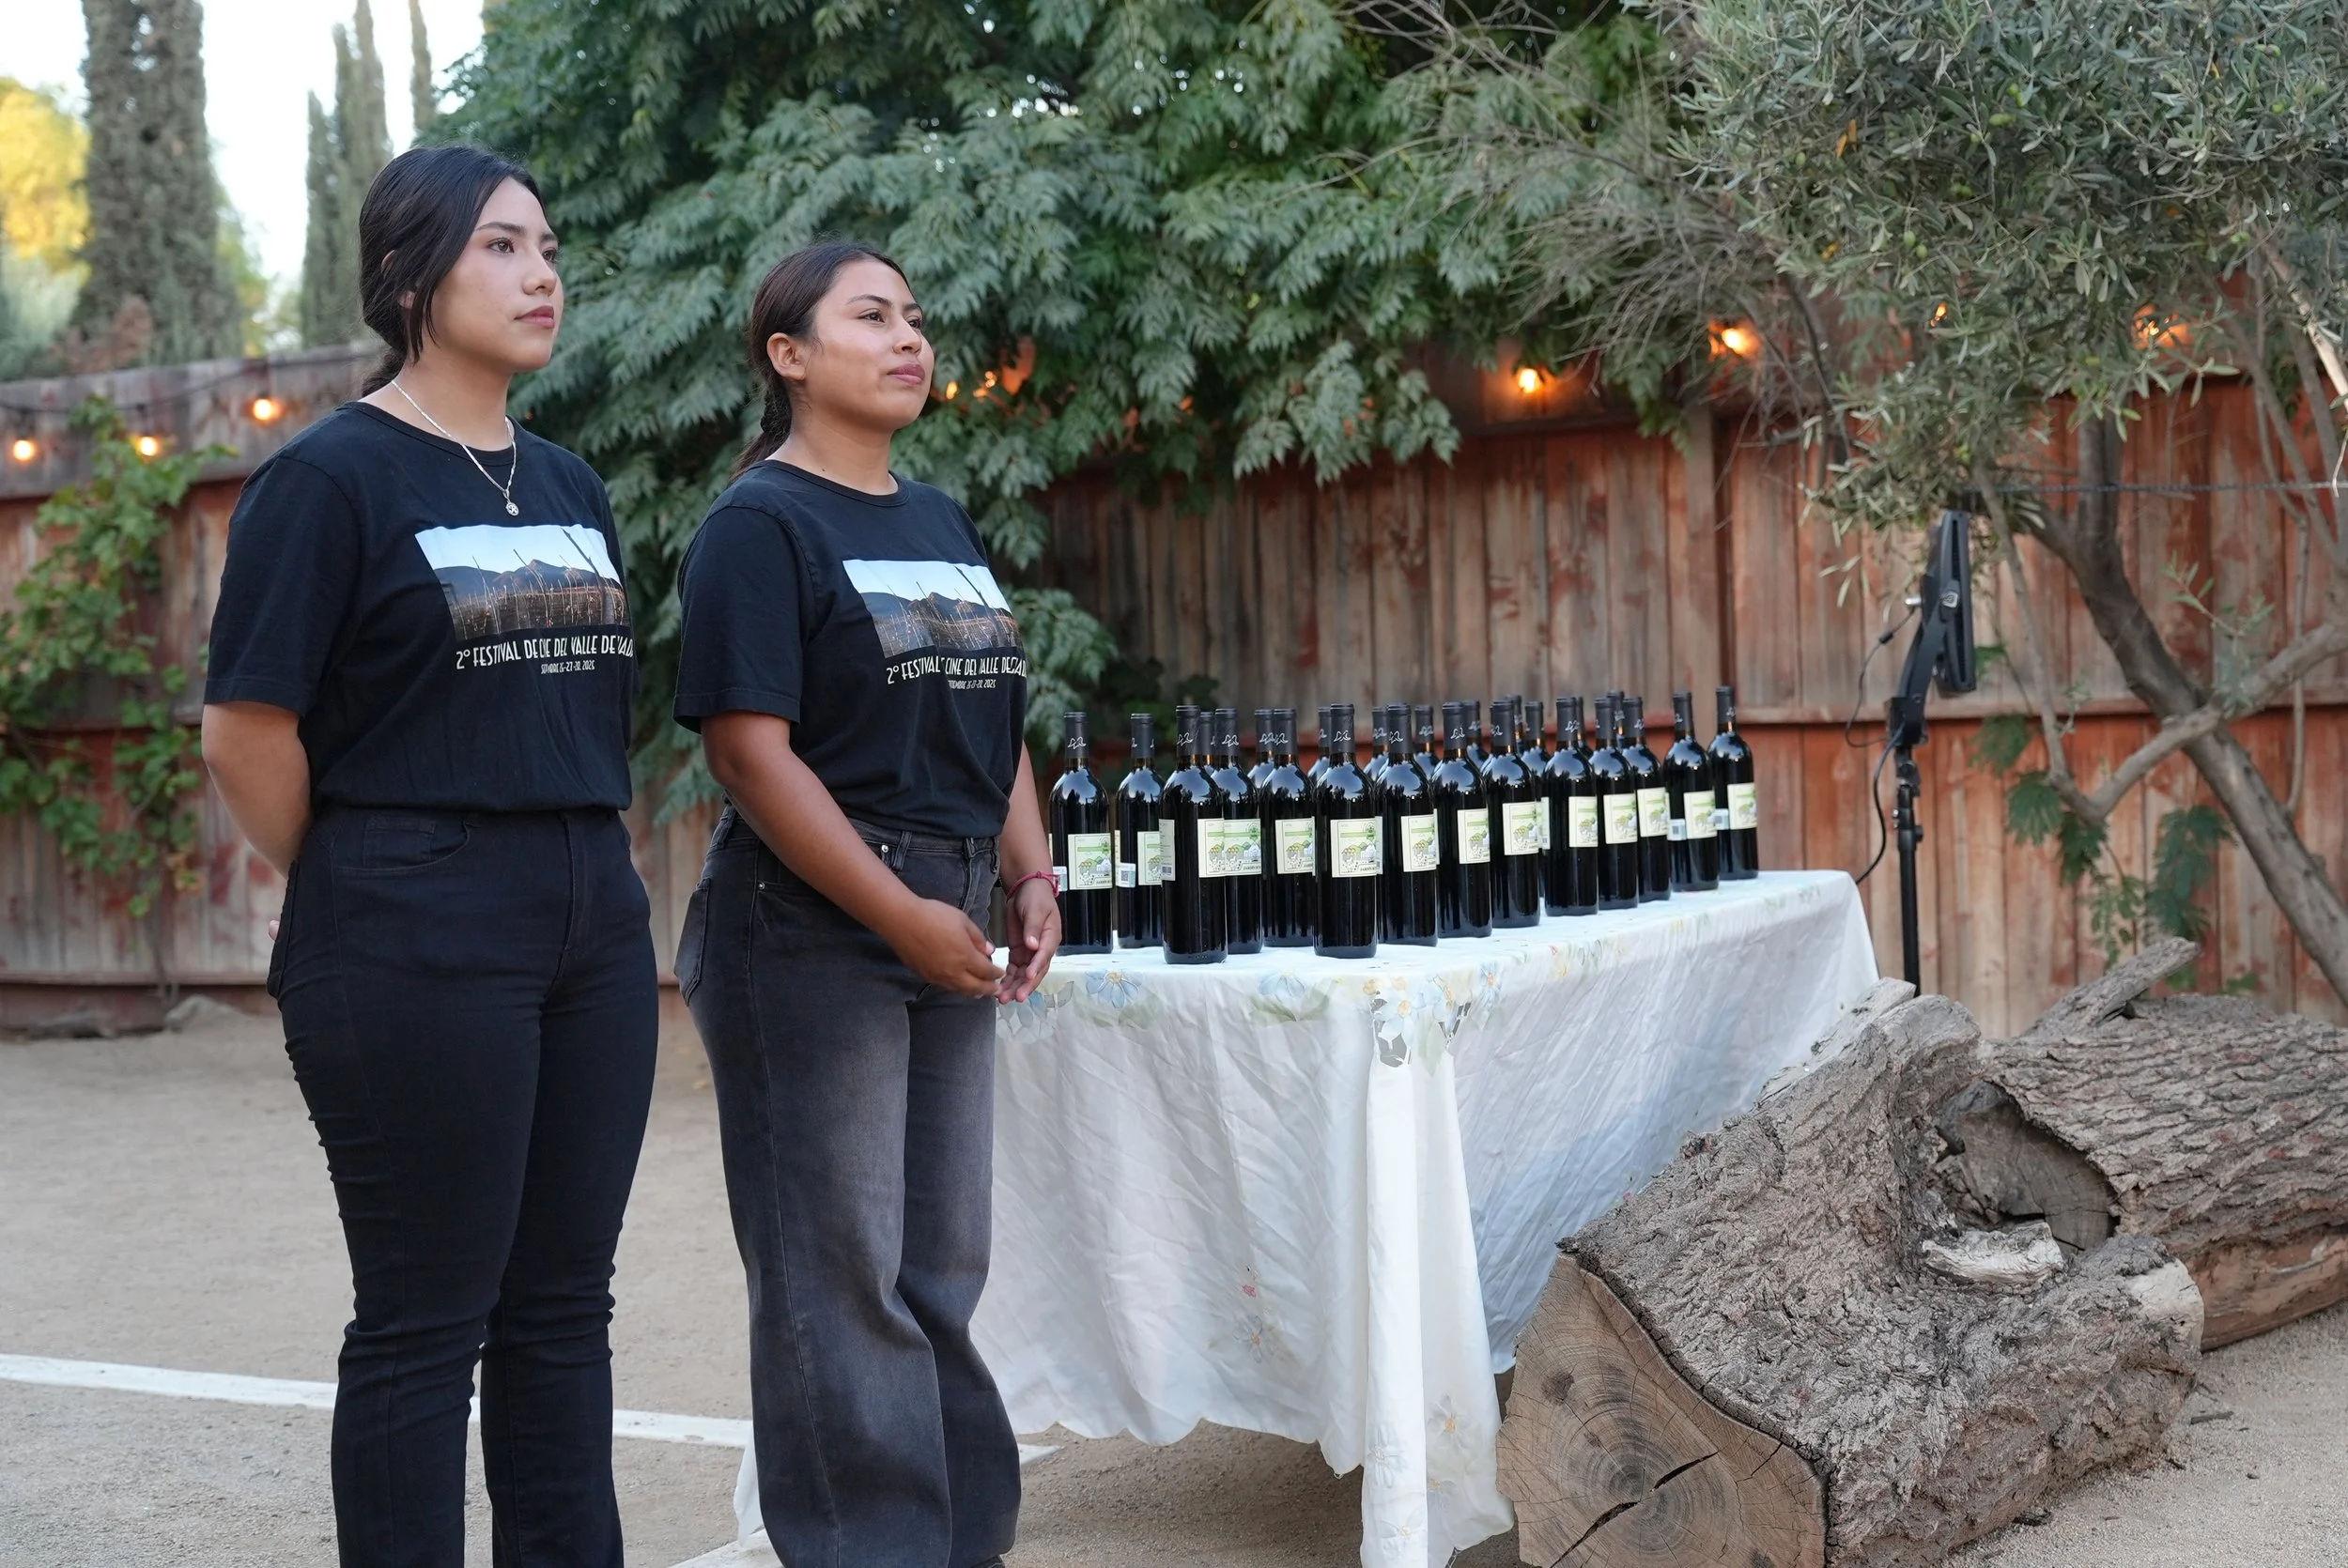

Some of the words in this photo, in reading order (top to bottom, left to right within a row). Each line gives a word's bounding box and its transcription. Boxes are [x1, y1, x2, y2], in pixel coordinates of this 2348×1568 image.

[456, 649, 471, 669] 2°
[473, 640, 521, 667] FESTIVAL
[523, 638, 538, 659] DE
[554, 638, 567, 657] DEL
[571, 635, 597, 656] VALLE
[600, 635, 616, 654] DE
[581, 660, 595, 670] 2025
[887, 665, 899, 684] 2°
[901, 655, 941, 681] FESTIVAL
[945, 657, 963, 675] CINE
[964, 658, 977, 676] DEL
[1001, 656, 1011, 674] DE
